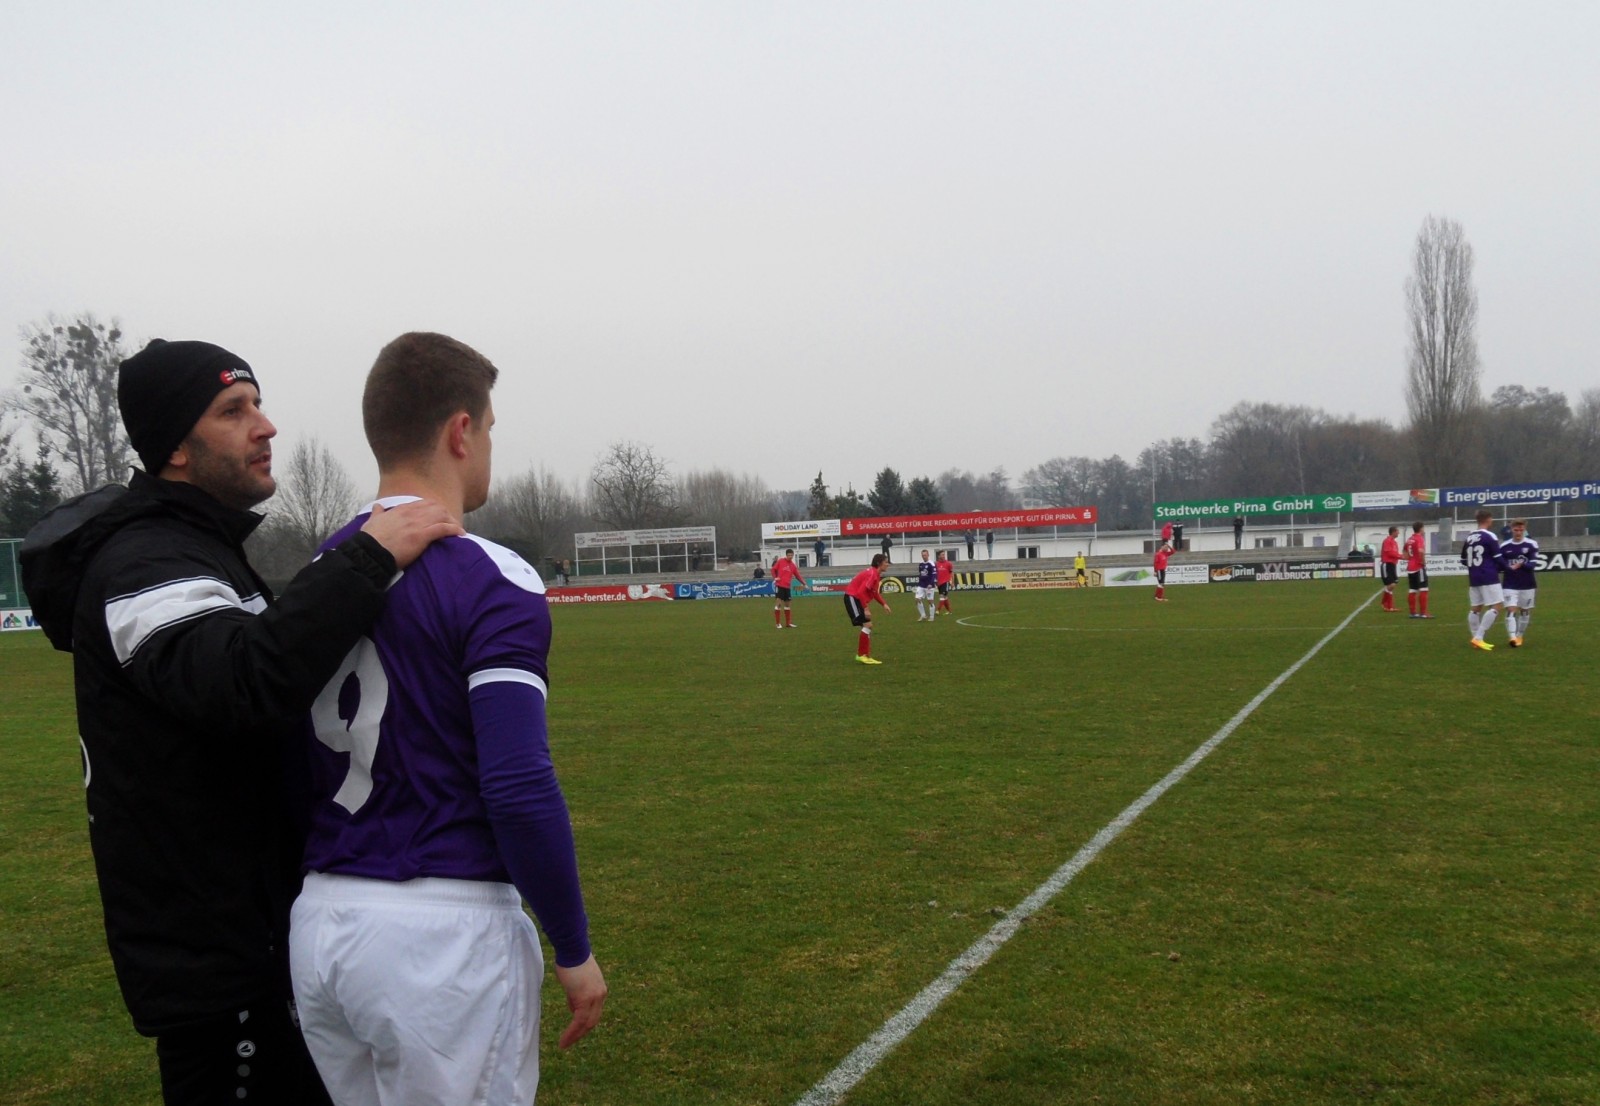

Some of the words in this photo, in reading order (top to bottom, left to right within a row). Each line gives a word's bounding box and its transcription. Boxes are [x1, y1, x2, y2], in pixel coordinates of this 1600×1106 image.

[1446, 487, 1580, 503] Energieversorgung
[1156, 502, 1229, 517] Stadtwerke
[1234, 501, 1266, 513] Pirna
[1272, 499, 1313, 511] GmbH
[859, 522, 894, 530] SPARKASSE.
[909, 520, 922, 528] FÜR
[974, 516, 987, 524] FÜR
[988, 516, 1002, 524] DEN
[1003, 515, 1025, 523] SPORT.
[1040, 513, 1054, 521] FÜR
[1467, 545, 1485, 567] 13
[1235, 567, 1255, 577] print
[1256, 571, 1311, 581] DIGITALDRUCK
[311, 634, 389, 815] 9
